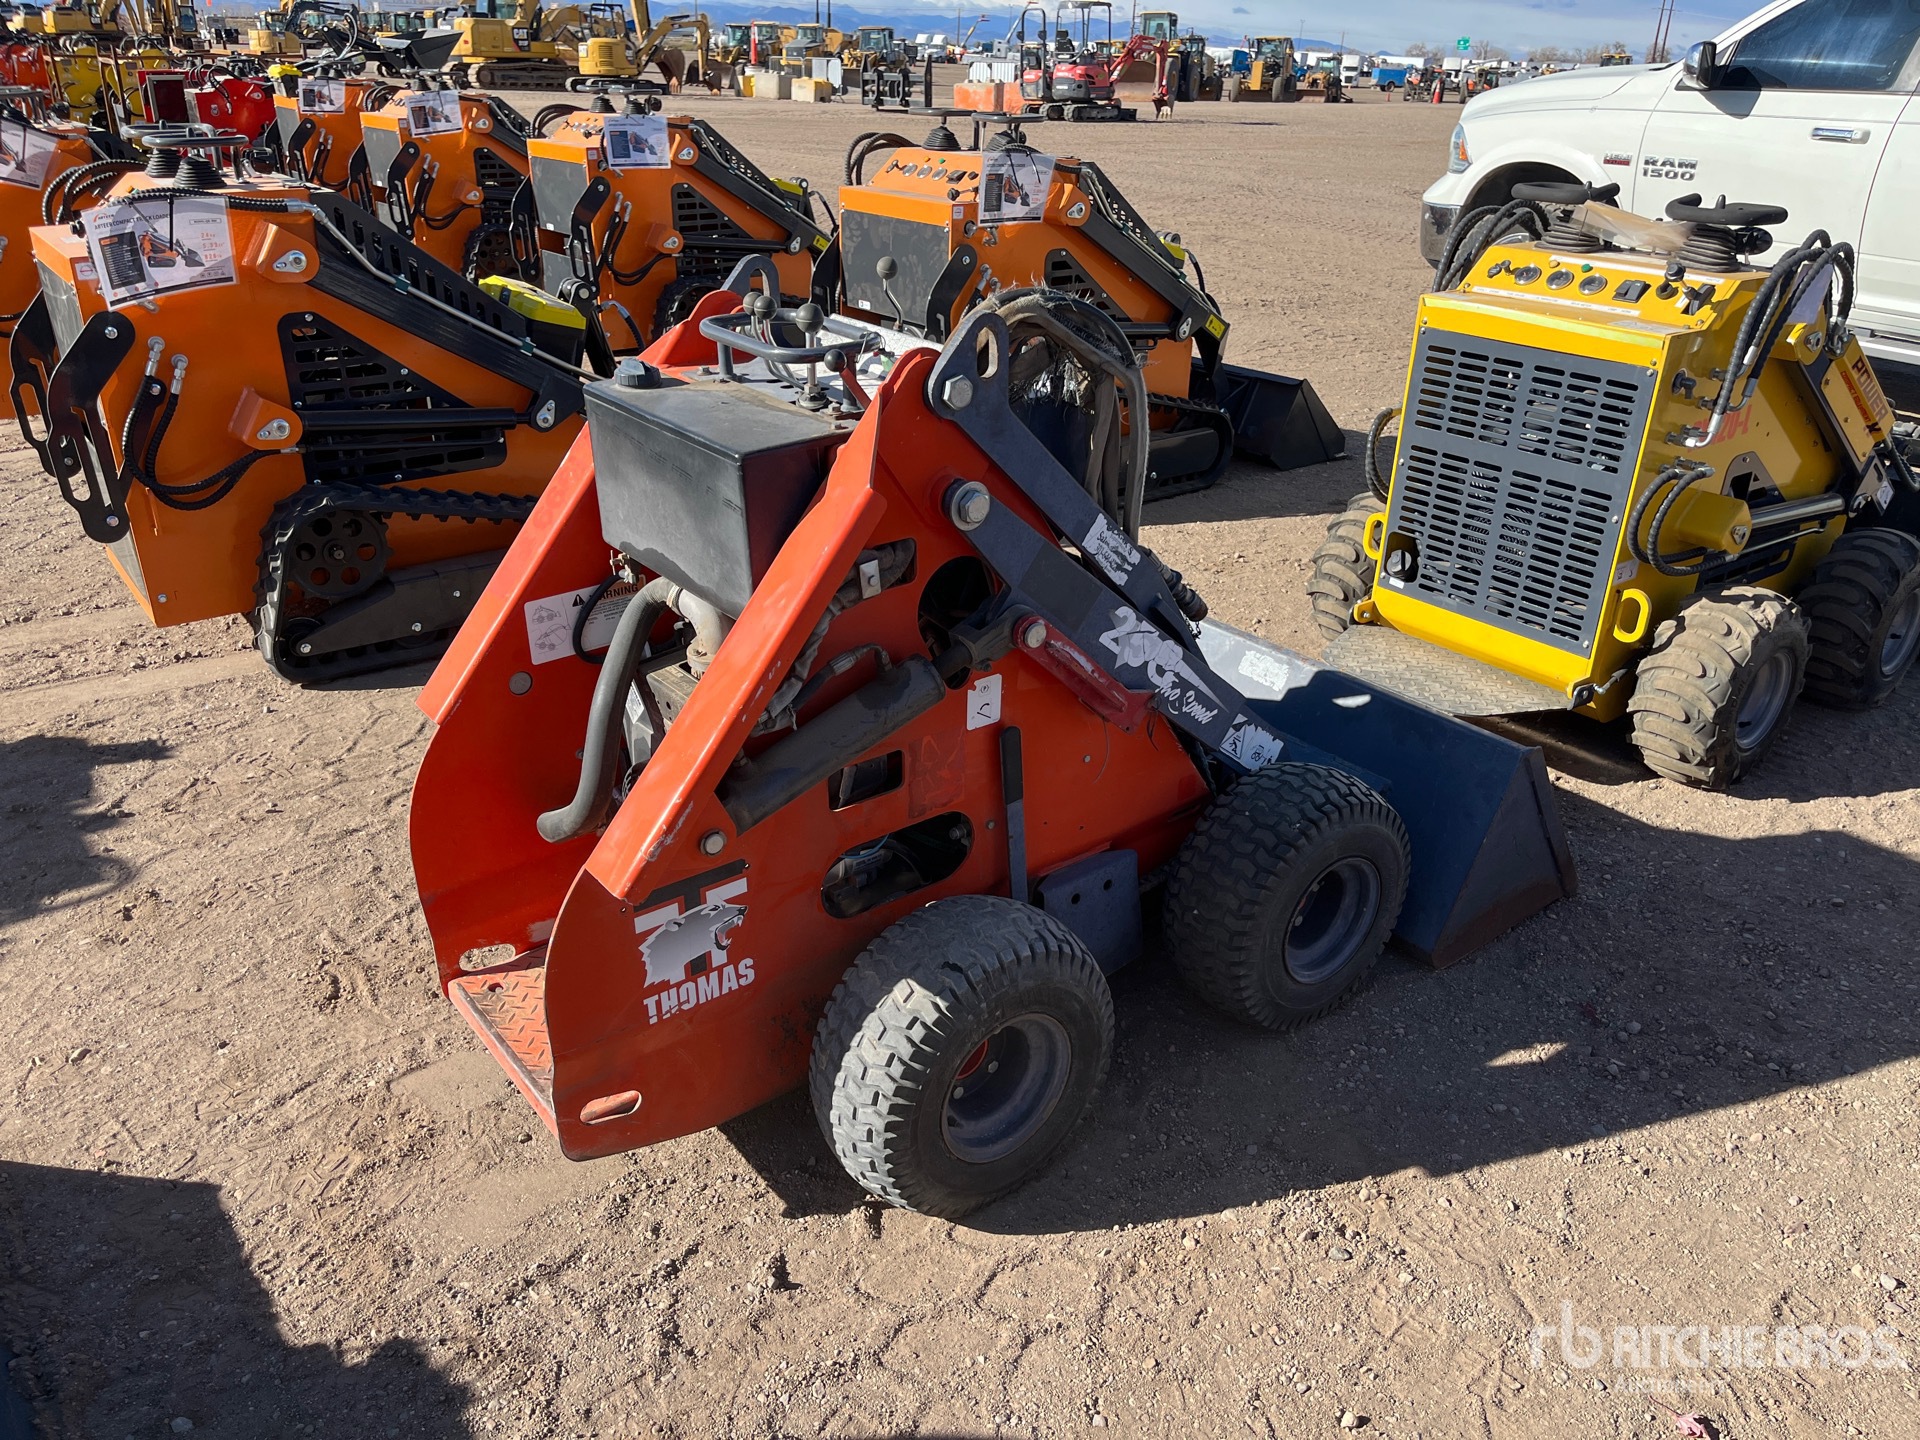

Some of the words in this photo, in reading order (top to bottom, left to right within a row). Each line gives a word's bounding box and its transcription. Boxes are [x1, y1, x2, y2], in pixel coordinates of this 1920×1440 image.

[513, 28, 528, 39] CAT
[1644, 156, 1698, 170] RAM
[1643, 167, 1696, 181] 1500
[1851, 355, 1889, 421] POWER
[597, 583, 639, 601] ARNING
[643, 957, 756, 1025] THOMAS
